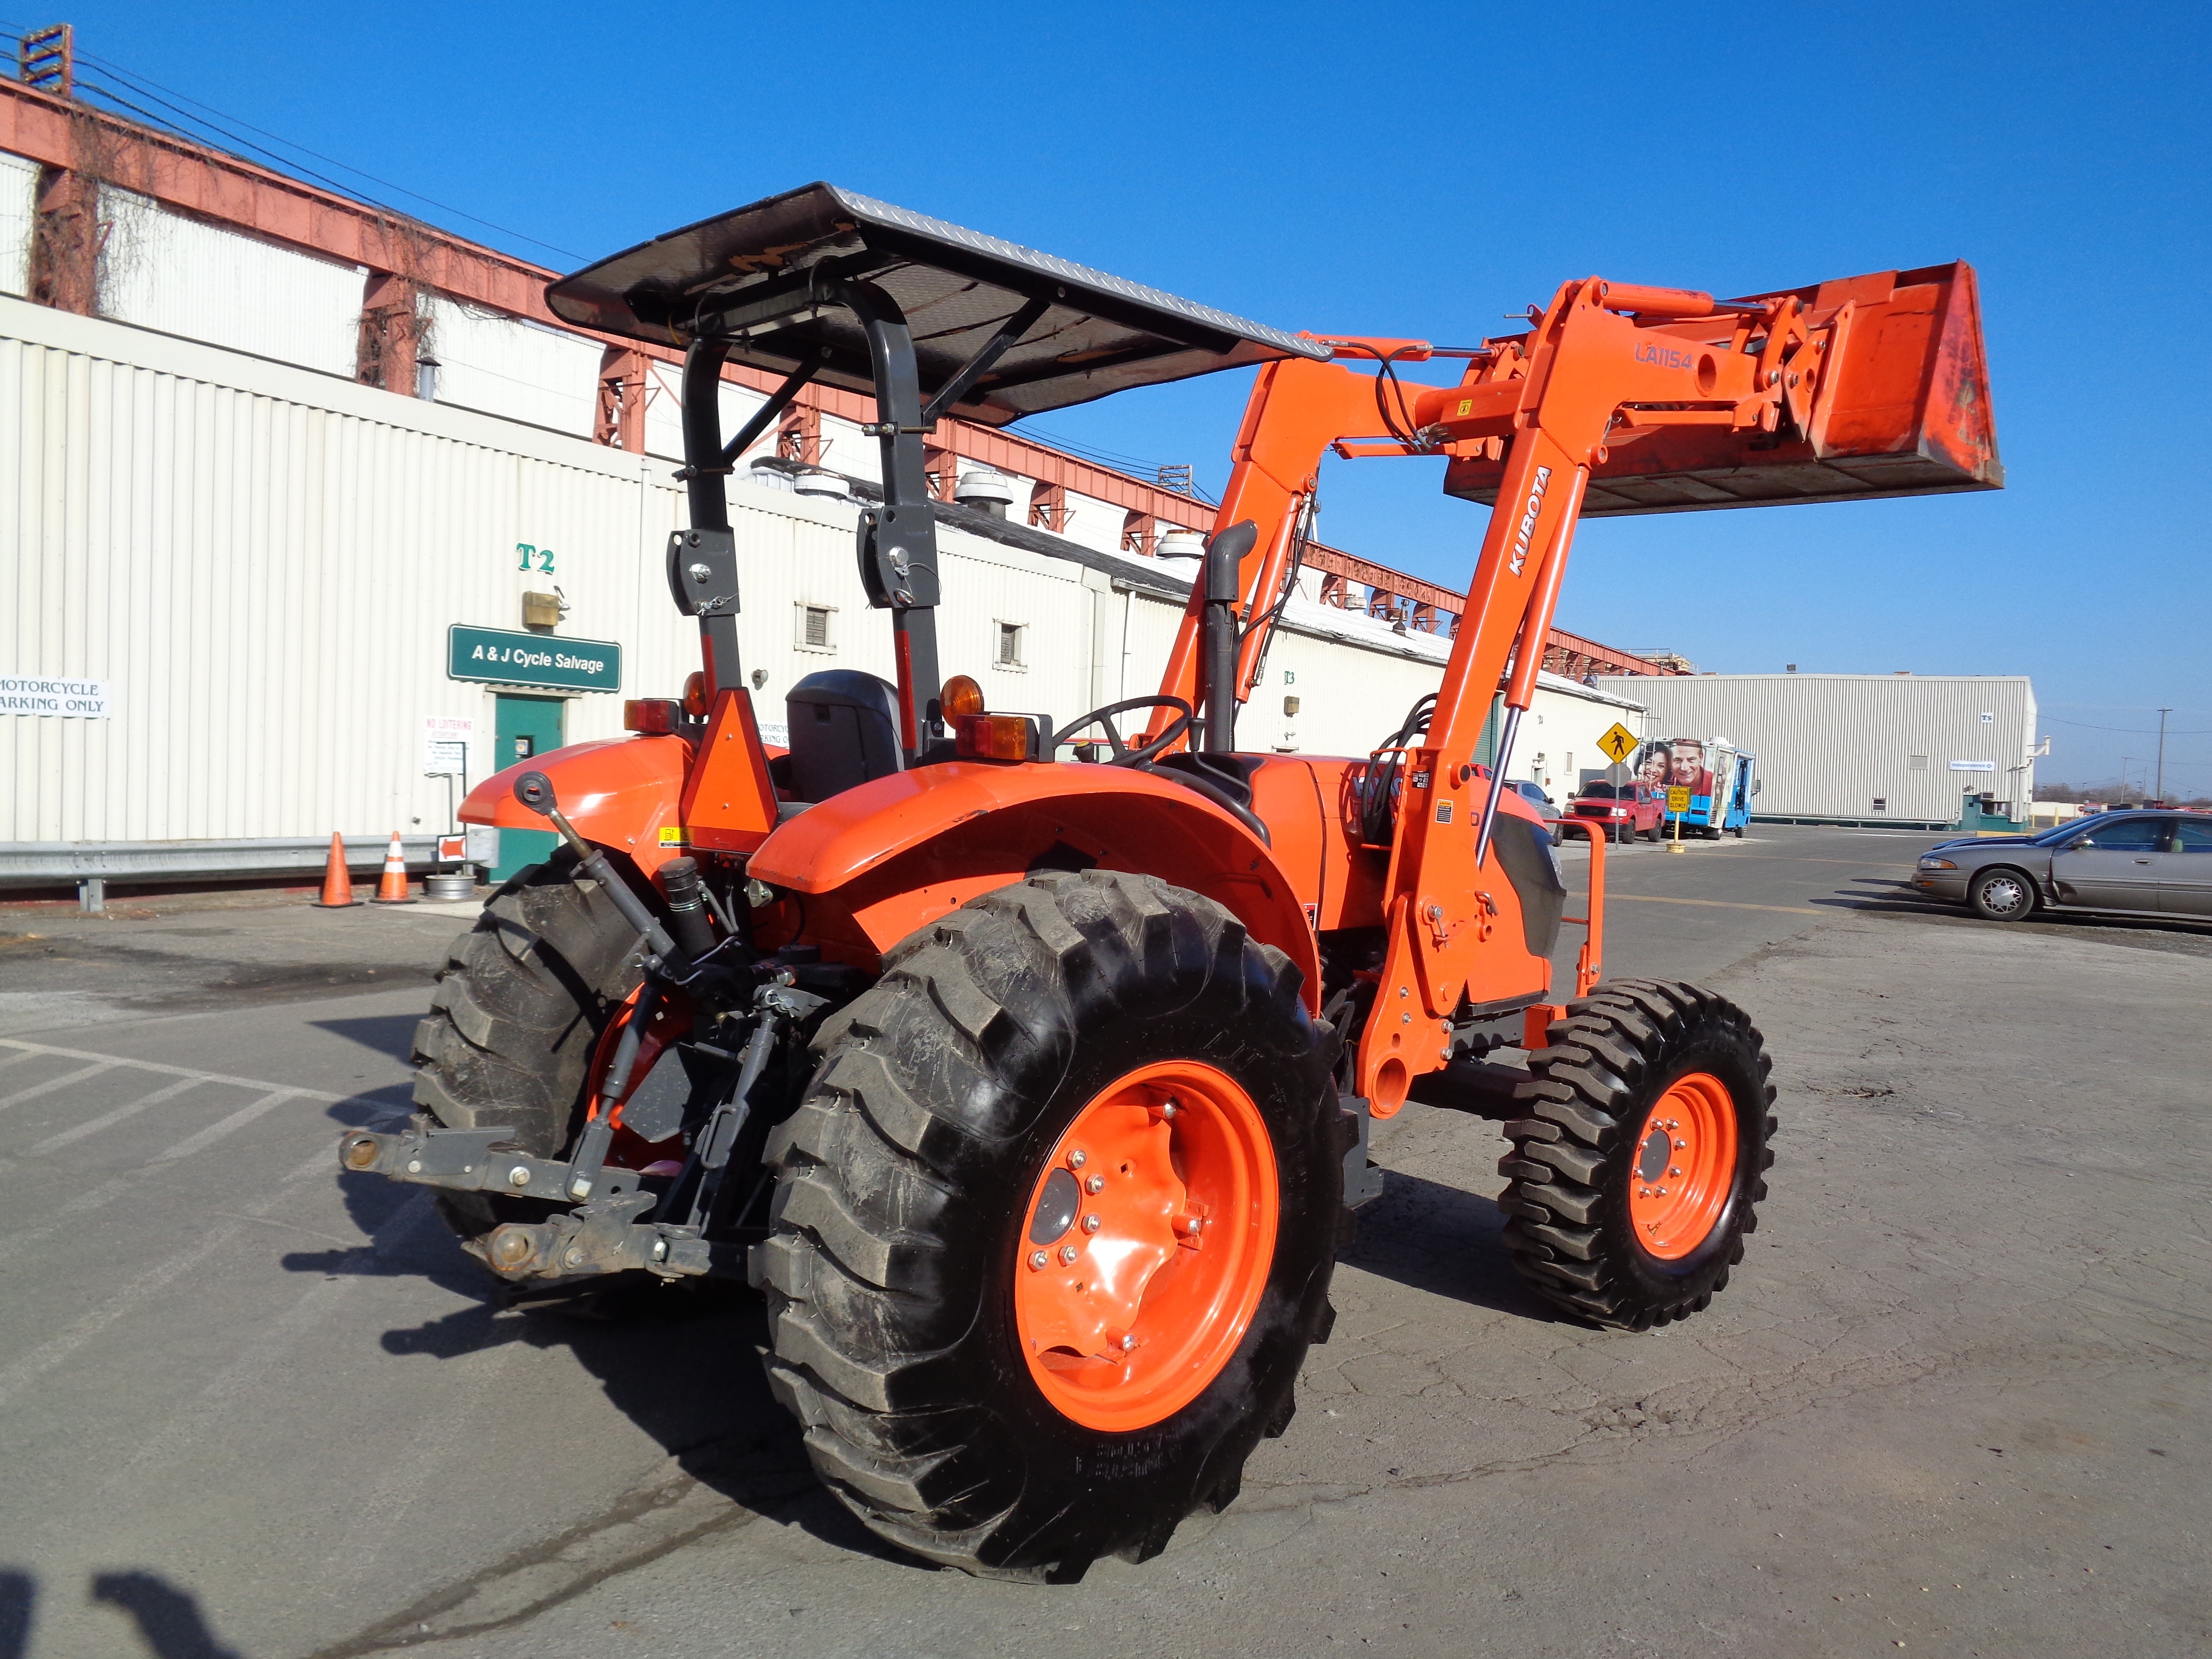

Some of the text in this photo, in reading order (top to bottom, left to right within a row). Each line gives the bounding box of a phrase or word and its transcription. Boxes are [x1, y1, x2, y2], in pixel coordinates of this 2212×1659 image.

[1635, 343, 1692, 371] LA1154
[1509, 465, 1552, 578] KUBOTA
[516, 542, 555, 574] T2
[471, 645, 604, 674] A & J Cycle Salvage
[0, 696, 104, 712] ARKING ONLY
[760, 735, 781, 743] RKING
